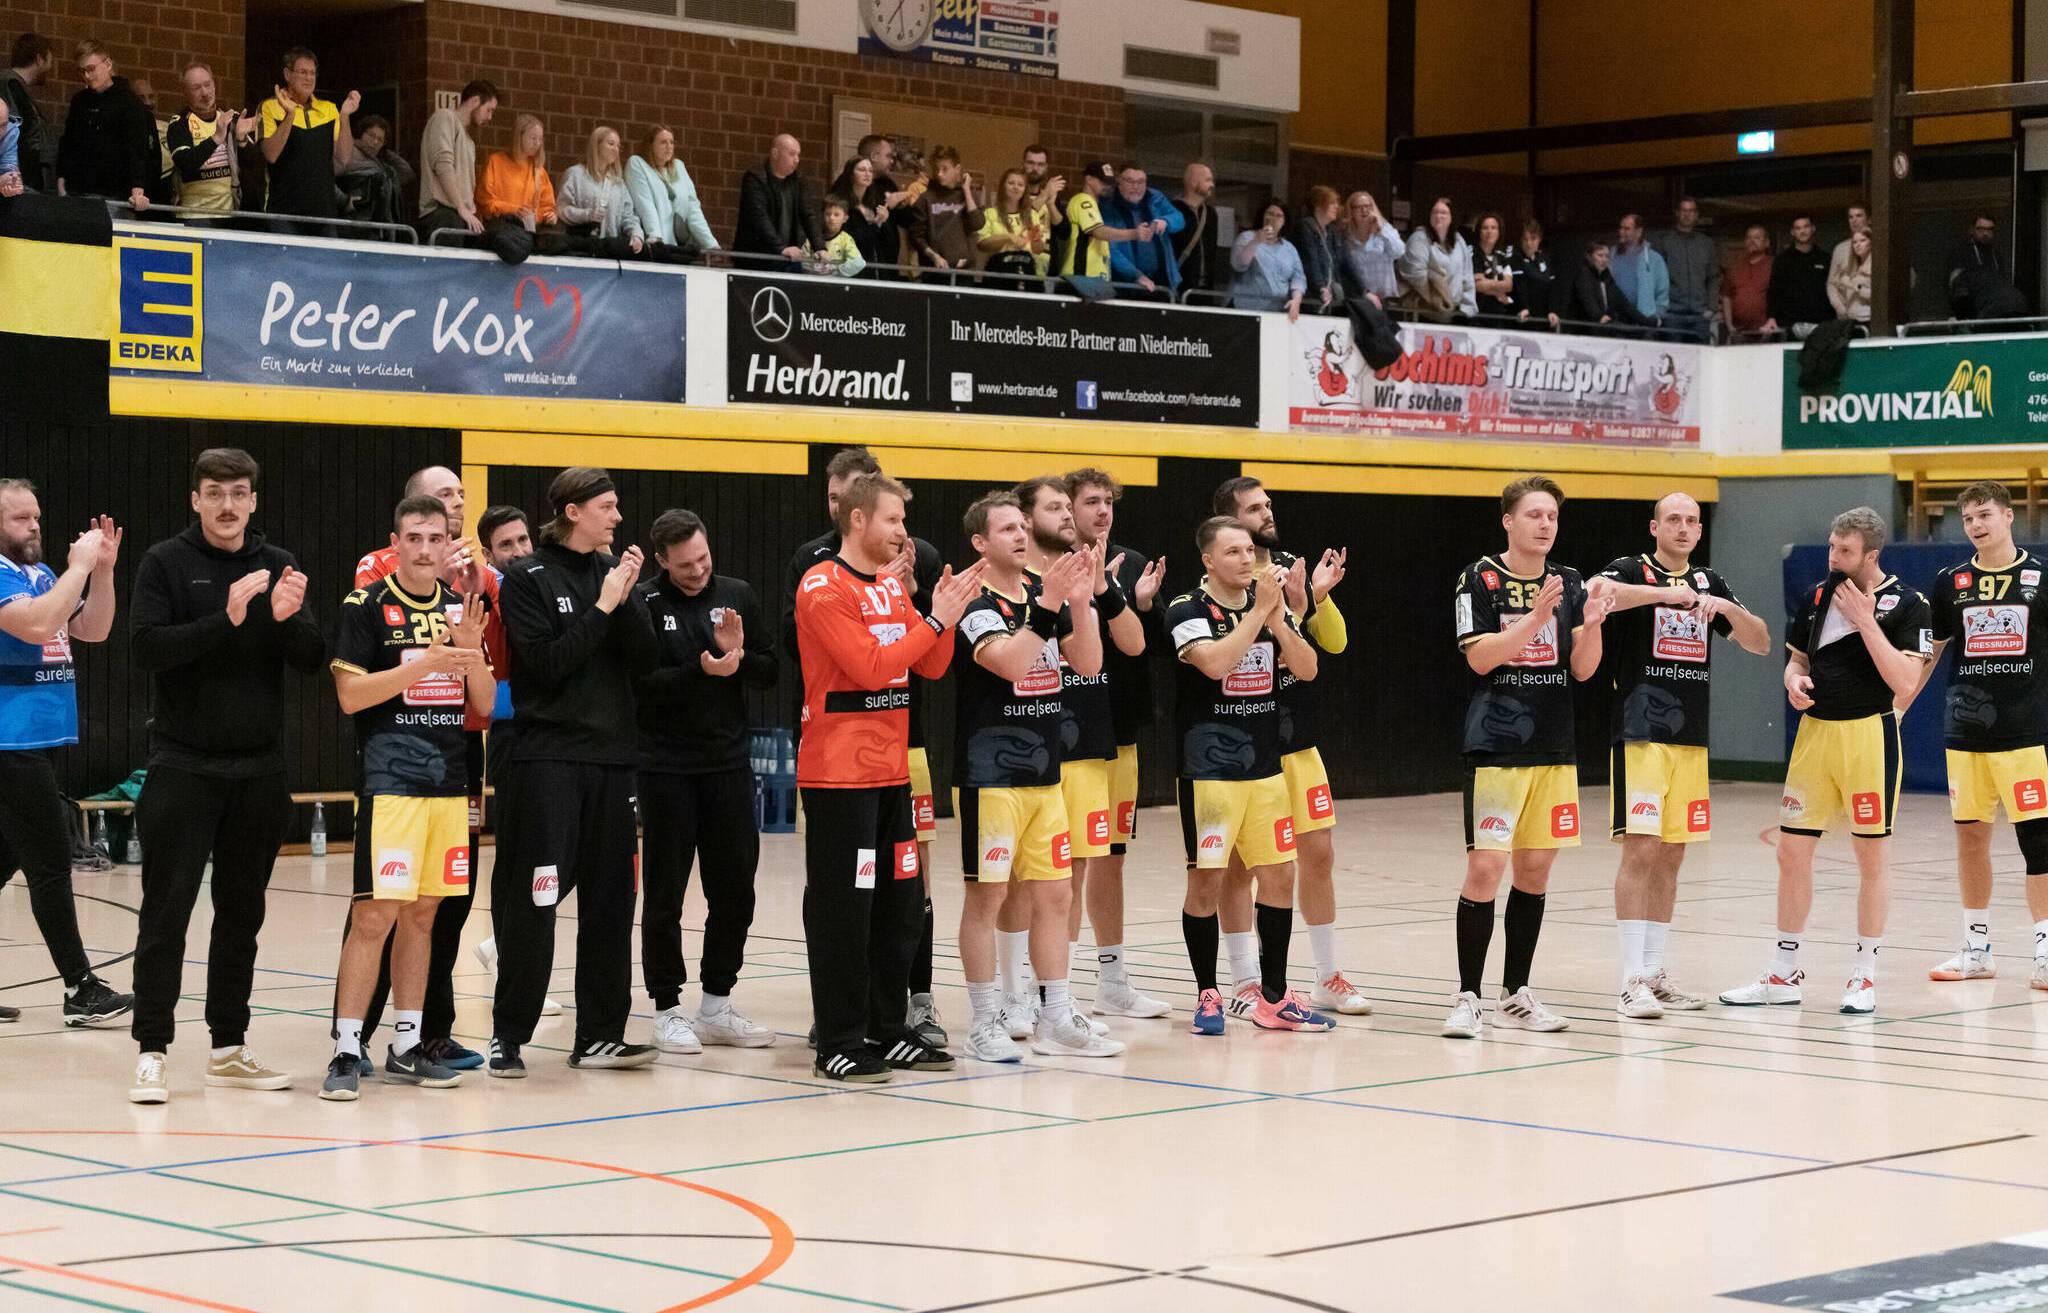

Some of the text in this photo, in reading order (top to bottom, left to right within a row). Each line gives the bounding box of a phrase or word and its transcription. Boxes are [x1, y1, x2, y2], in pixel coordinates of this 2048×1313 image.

[260, 281, 534, 364] Peter Kox
[800, 312, 906, 337] Mercedes-Benz
[119, 342, 196, 362] EDEKA
[950, 320, 1212, 358] Ihr Mercedes-Benz Partner am Niederrhein.
[260, 356, 281, 371] Ein
[286, 358, 323, 374] Markt
[328, 363, 352, 376] zum
[746, 353, 910, 402] Herbrand.
[1374, 335, 1633, 401] ochims-Transport
[977, 381, 1058, 398] www.herbrand.de
[1101, 389, 1241, 408] www.facebook.com/herbrand.de
[1375, 386, 1404, 408] Wir
[1408, 389, 1463, 412] suchen
[1468, 392, 1509, 415] Dich!
[2027, 394, 2048, 405] 476
[1799, 390, 1983, 424] PROVINZIAL
[1505, 581, 1541, 608] 33
[1978, 575, 2013, 601] 97
[556, 597, 573, 614] 31
[410, 612, 451, 645] 26
[664, 615, 677, 631] 23
